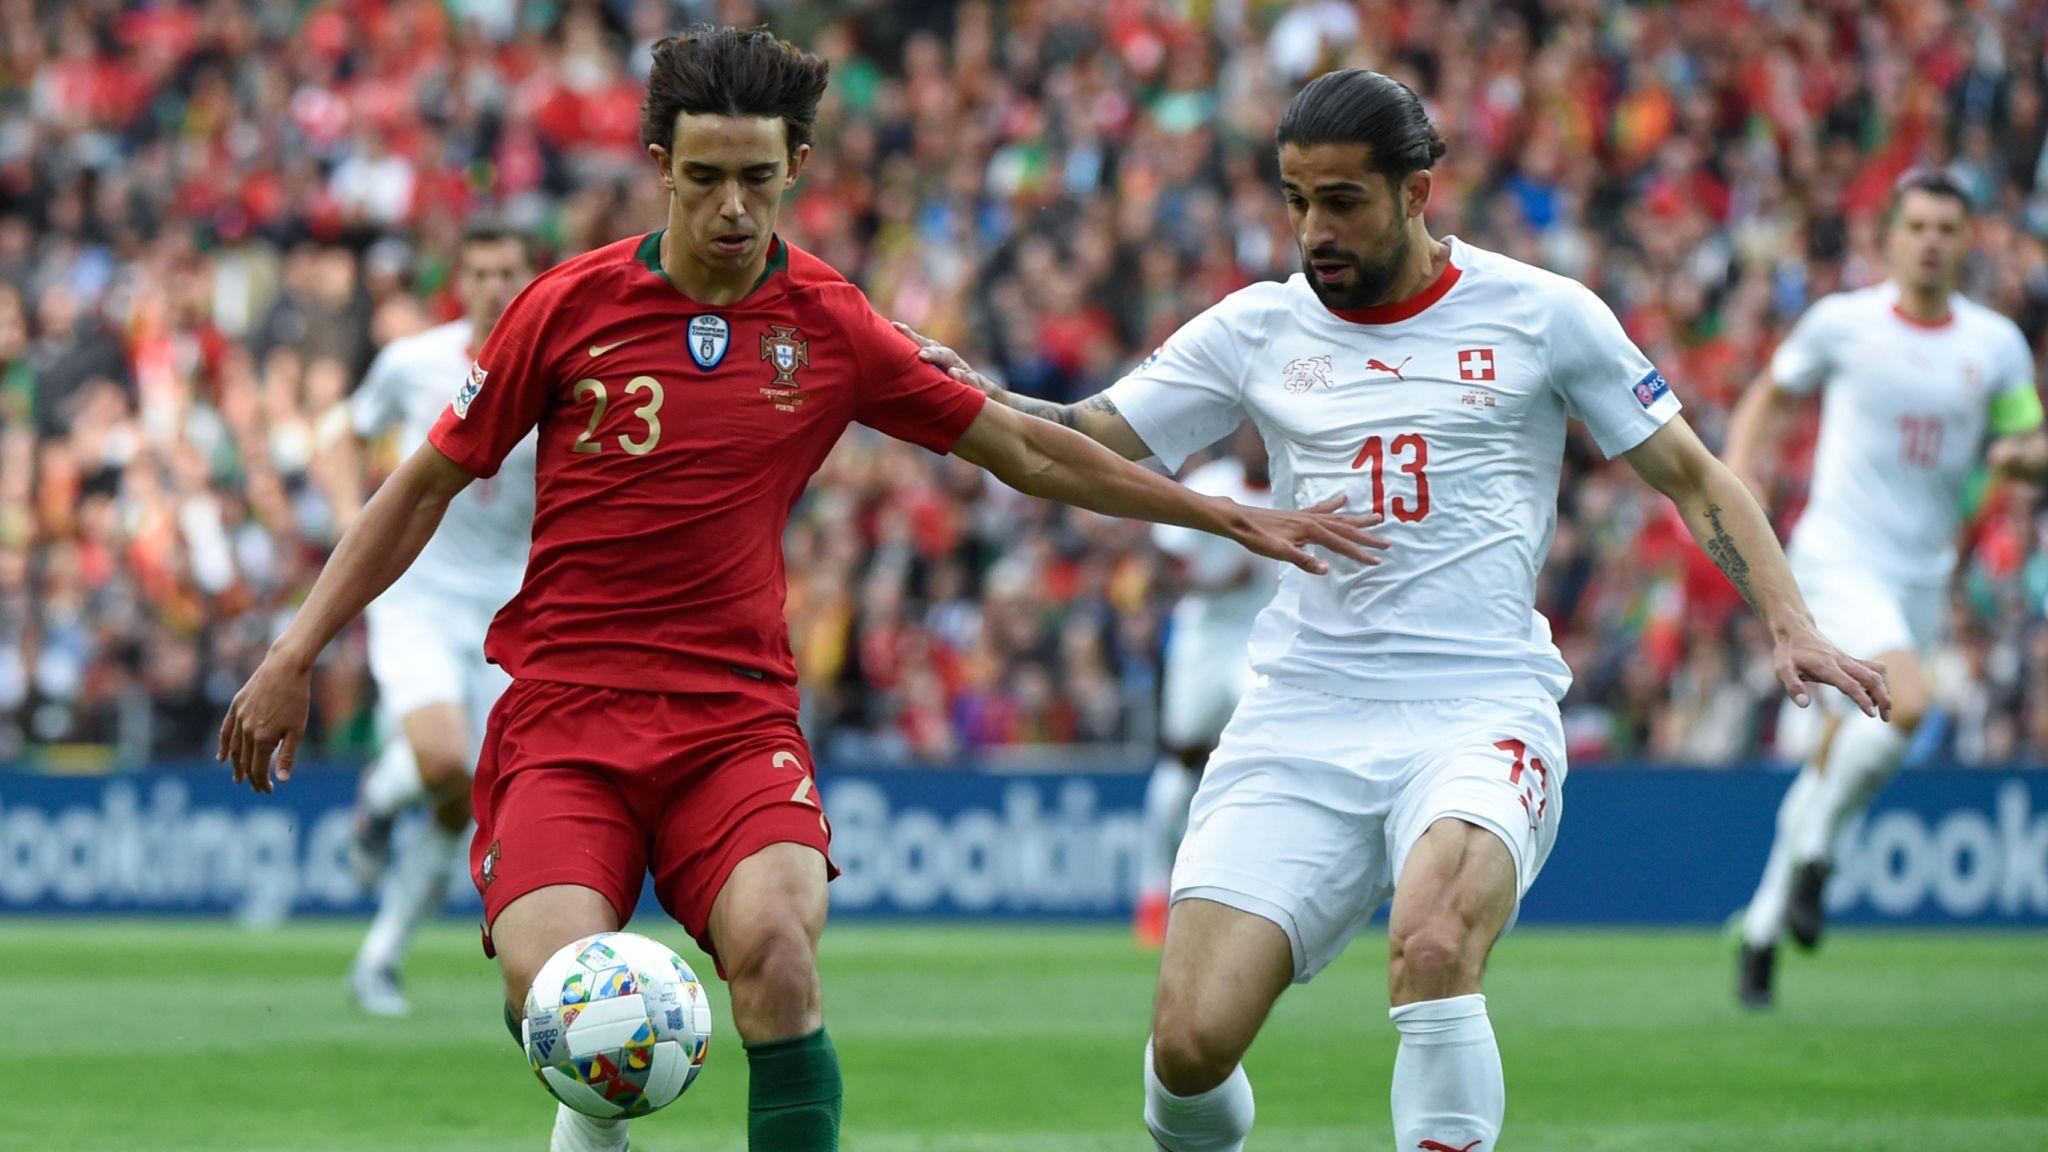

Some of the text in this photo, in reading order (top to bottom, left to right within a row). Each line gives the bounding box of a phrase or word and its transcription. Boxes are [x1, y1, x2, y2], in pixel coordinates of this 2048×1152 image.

[692, 325, 726, 333] EUROPEAN
[572, 375, 665, 456] 23
[1351, 433, 1430, 524] 13
[772, 751, 829, 834] 2
[826, 779, 1150, 910] Bookin
